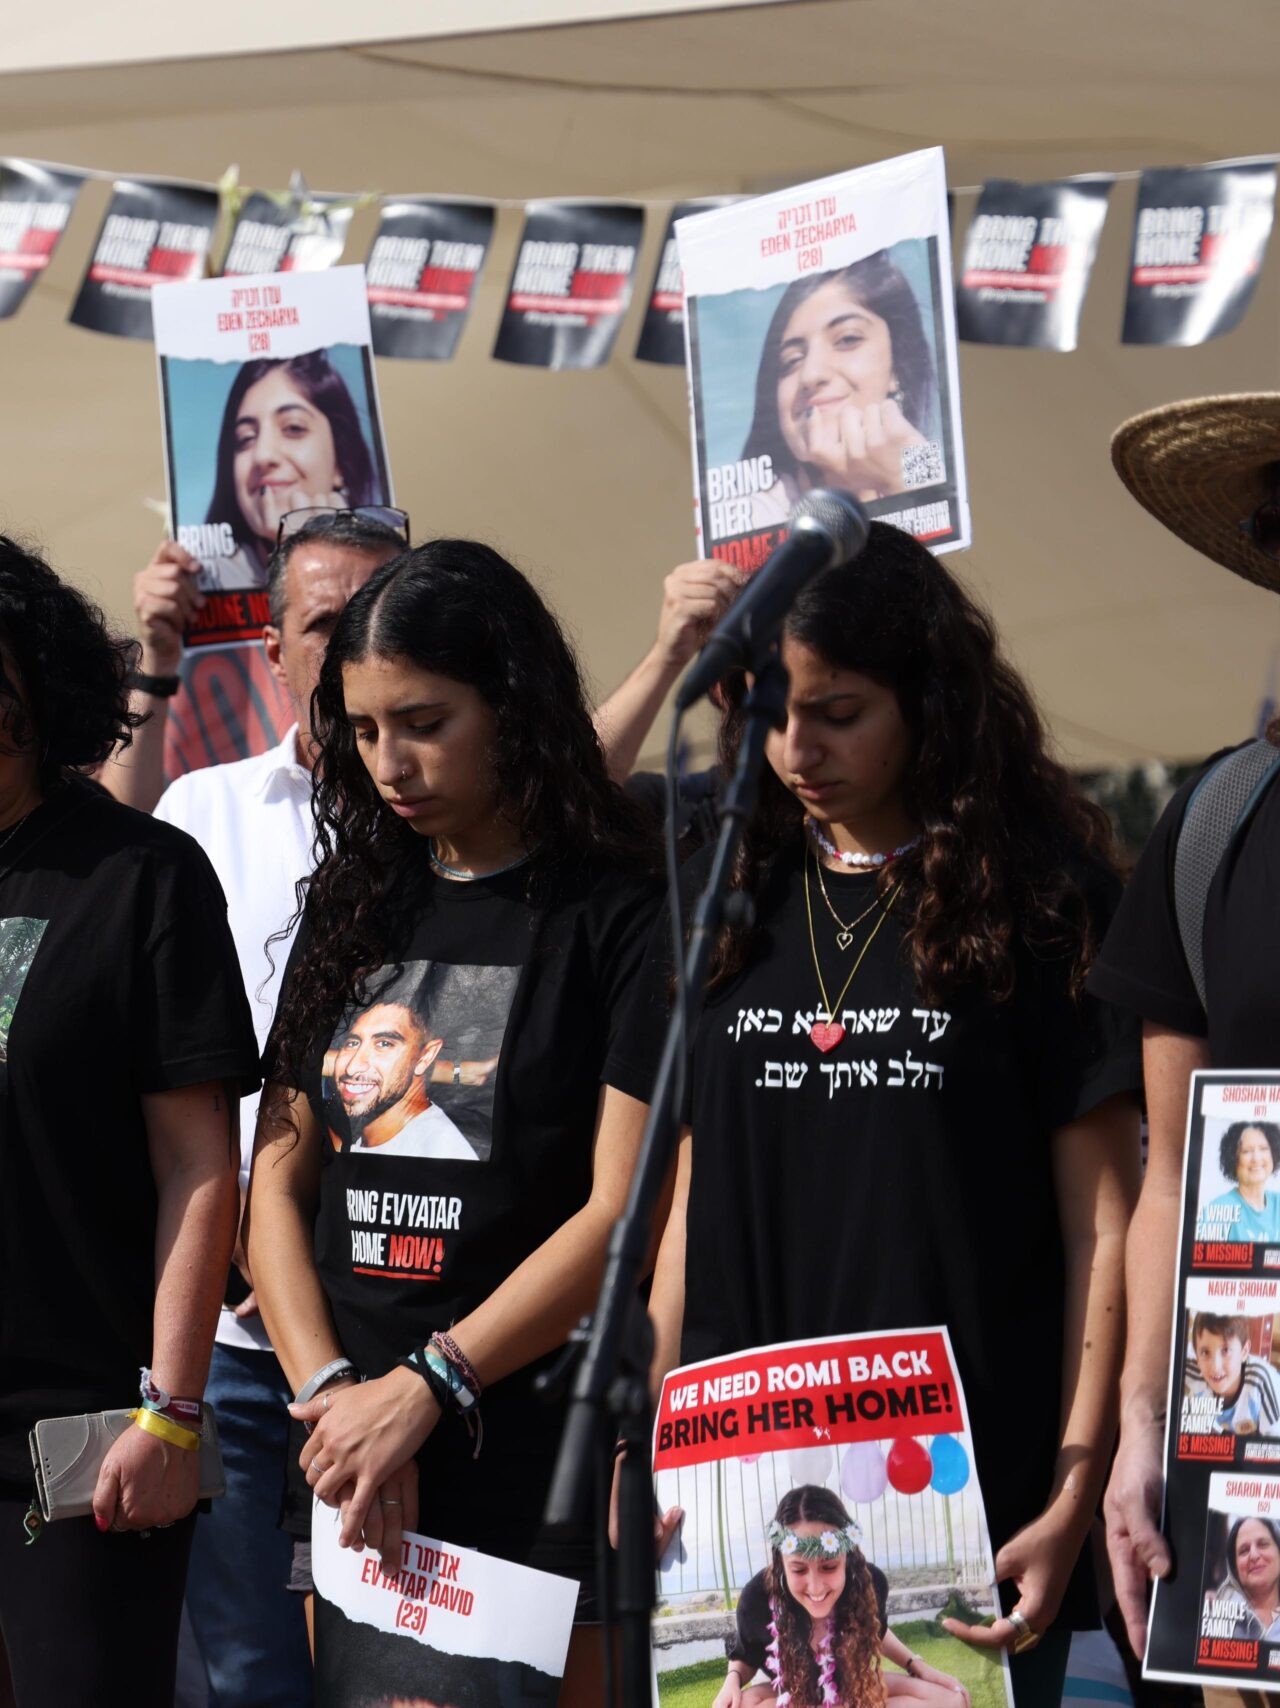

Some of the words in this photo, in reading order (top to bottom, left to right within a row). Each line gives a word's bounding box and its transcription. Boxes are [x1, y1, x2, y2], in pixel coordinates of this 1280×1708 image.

[761, 233, 791, 257] EDEN
[794, 213, 857, 249] ZECHARYA
[798, 245, 823, 272] (28)
[707, 455, 773, 503] BRING
[710, 501, 753, 540] HER
[178, 522, 236, 557] BRING
[727, 1008, 783, 1042] כאן.
[841, 1008, 900, 1034] שאת
[912, 1009, 951, 1042] עד
[755, 1061, 808, 1088] שם.
[820, 1059, 877, 1100] איתך
[887, 1050, 944, 1090] הלב
[1222, 1086, 1266, 1103] SHOSHAN
[381, 1192, 462, 1230] EVYATAR
[1196, 1204, 1204, 1221] A
[1207, 1204, 1241, 1223] WHOLE
[1195, 1222, 1231, 1241] FAMILY
[351, 1230, 387, 1266] HOME
[388, 1234, 444, 1273] NOW!
[1193, 1243, 1204, 1261] IS
[1206, 1243, 1254, 1263] MISSING!
[1208, 1280, 1237, 1297] NAVEH
[1239, 1281, 1277, 1298] SHOHAM
[670, 1382, 699, 1413] WE
[703, 1371, 761, 1406] NEED
[767, 1358, 841, 1393] ROMI
[847, 1350, 933, 1383] BACK
[658, 1408, 739, 1452] BRING
[747, 1397, 817, 1434] HER
[826, 1382, 954, 1424] HOME!
[1182, 1396, 1190, 1414] A
[1191, 1396, 1224, 1415] WHOLE
[1181, 1414, 1214, 1434] FAMILY
[1179, 1435, 1189, 1453] IS
[1190, 1435, 1236, 1455] MISSING!
[1226, 1480, 1262, 1498] SHARON
[415, 1544, 460, 1582] אביתר
[429, 1580, 474, 1617] DAVID
[1202, 1599, 1210, 1617] A
[1210, 1600, 1247, 1620] WHOLE
[396, 1599, 428, 1635] (23)
[1201, 1618, 1237, 1639] FAMILY
[1200, 1639, 1209, 1656] IS
[1211, 1640, 1258, 1661] MISSING!
